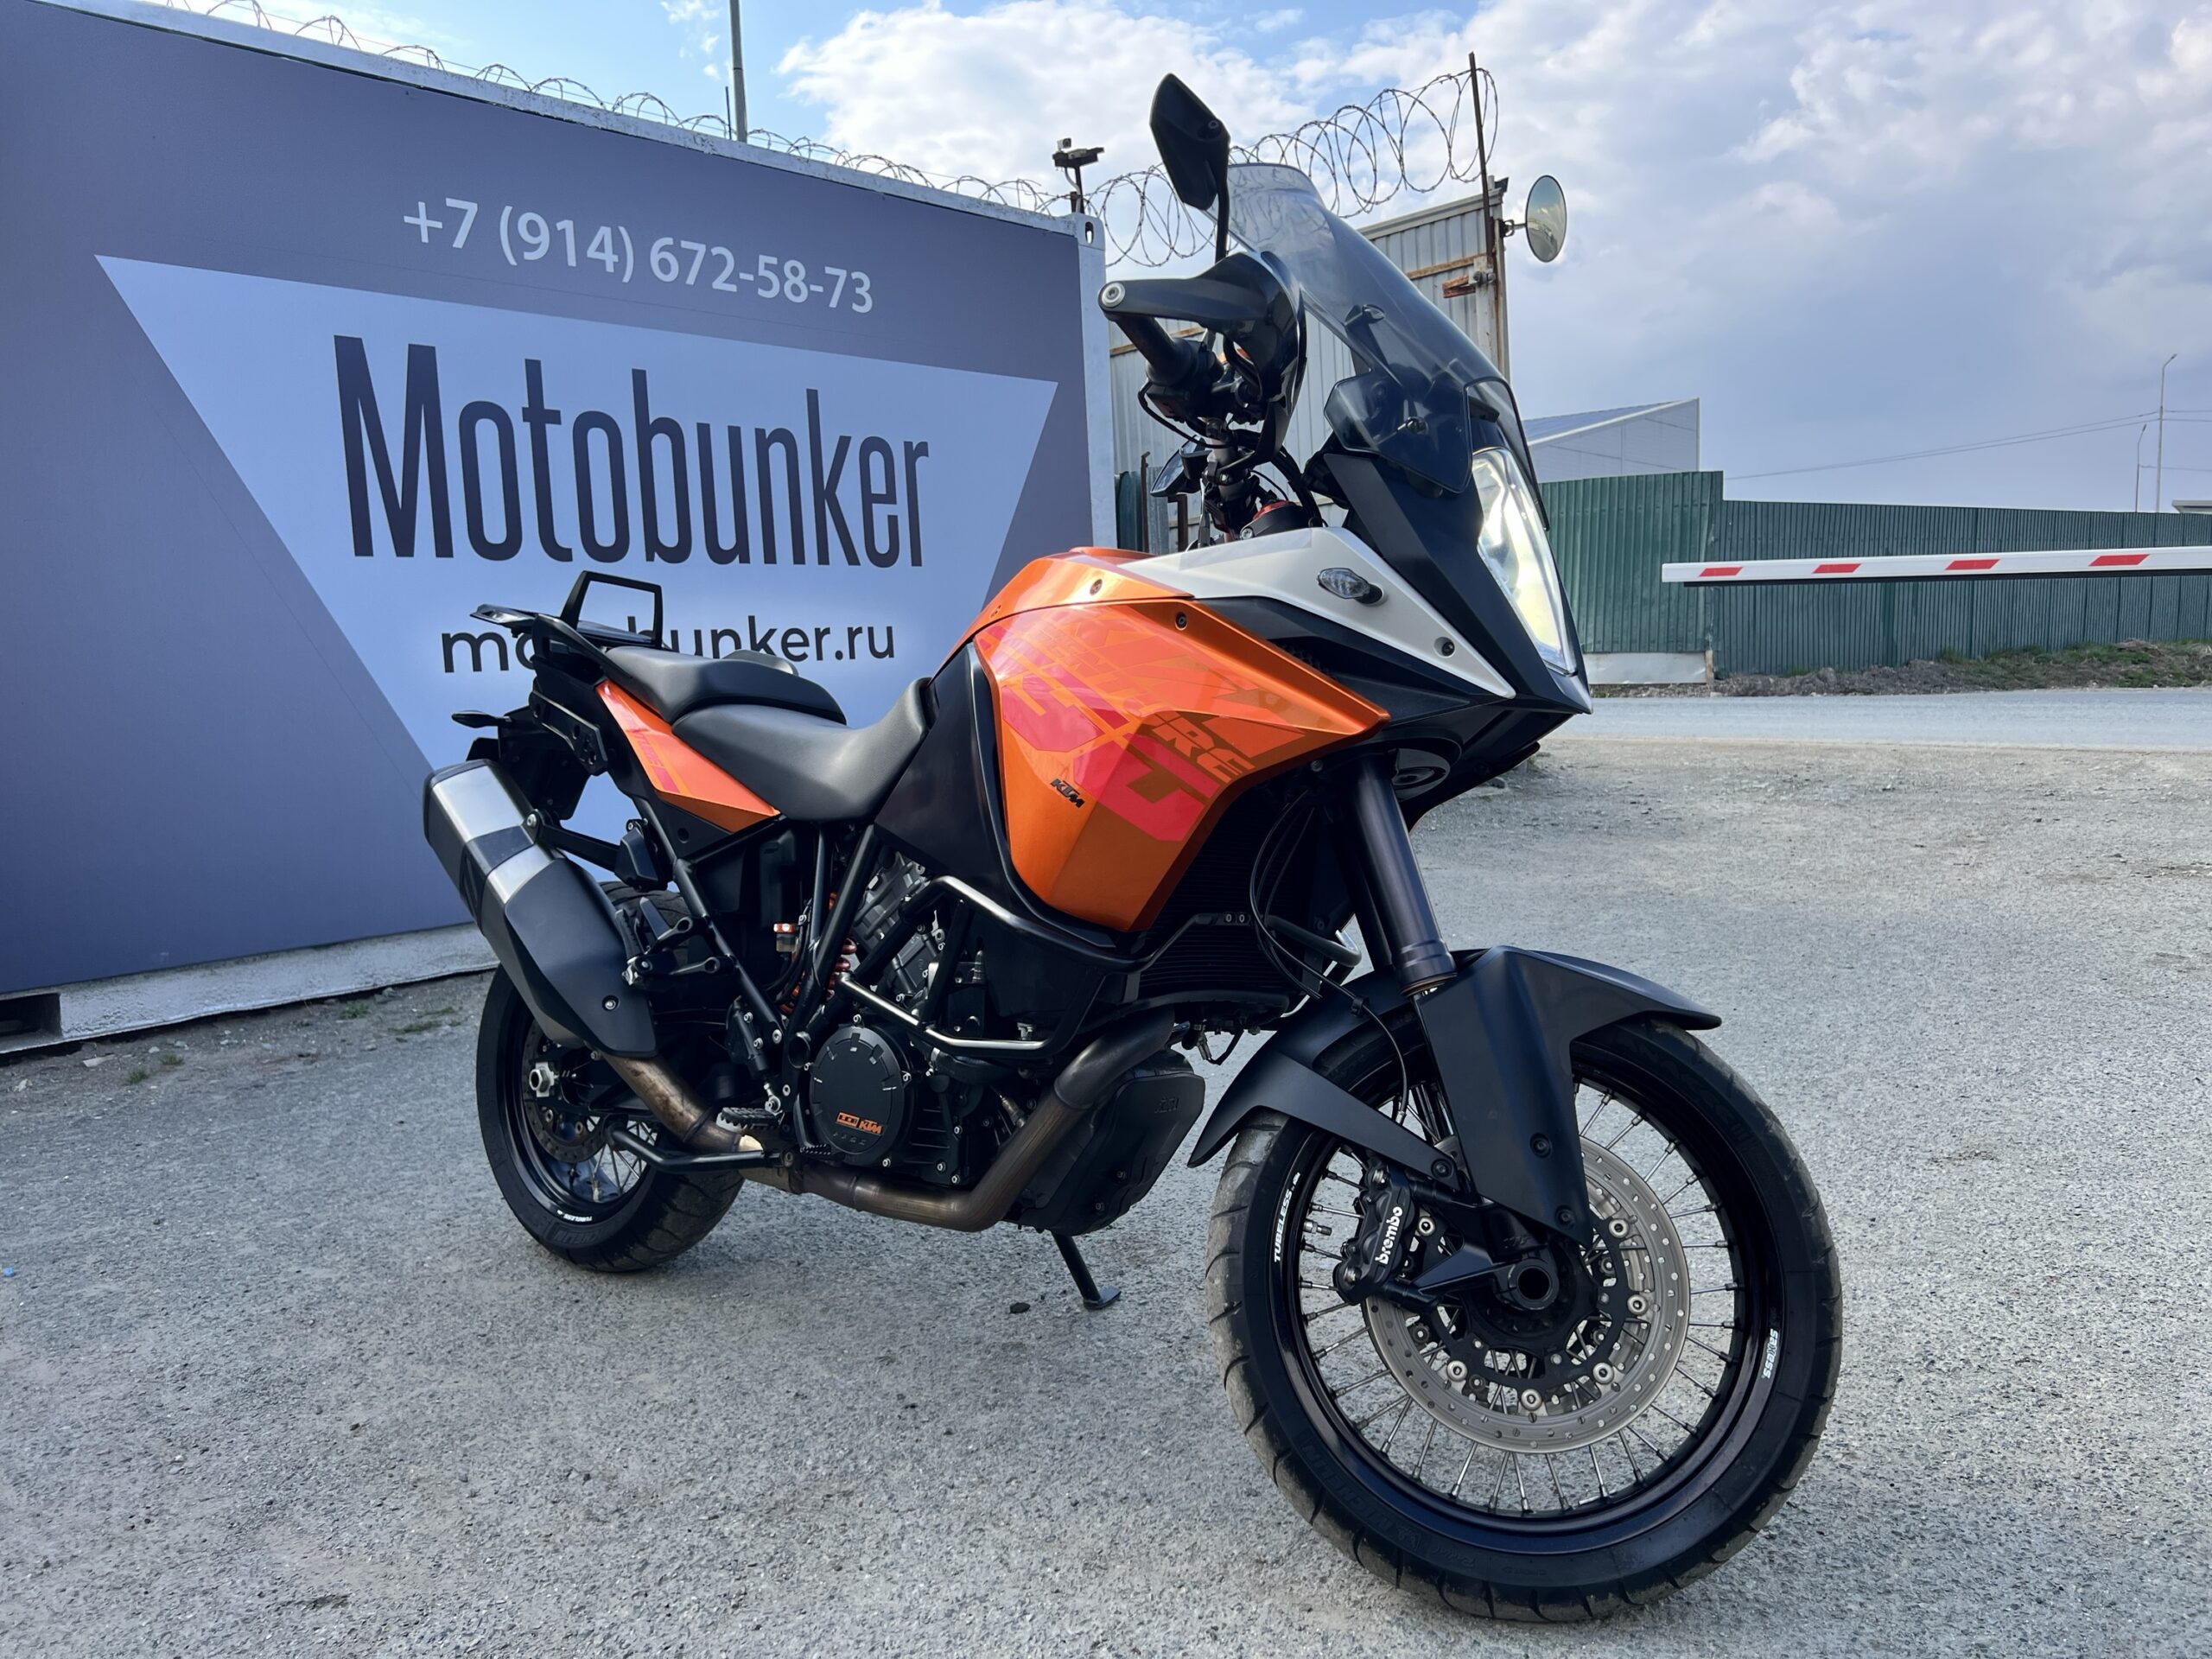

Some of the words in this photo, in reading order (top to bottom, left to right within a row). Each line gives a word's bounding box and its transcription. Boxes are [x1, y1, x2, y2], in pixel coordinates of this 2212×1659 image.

[404, 198, 478, 249] +7
[499, 206, 634, 283] (914)
[650, 237, 873, 313] 672-58-73
[334, 334, 930, 568] Motobunker
[442, 614, 895, 673] munker.ru
[1051, 779, 1085, 808] KTM
[1274, 1188, 1294, 1262] TUBELESS
[1375, 1206, 1403, 1264] brembo
